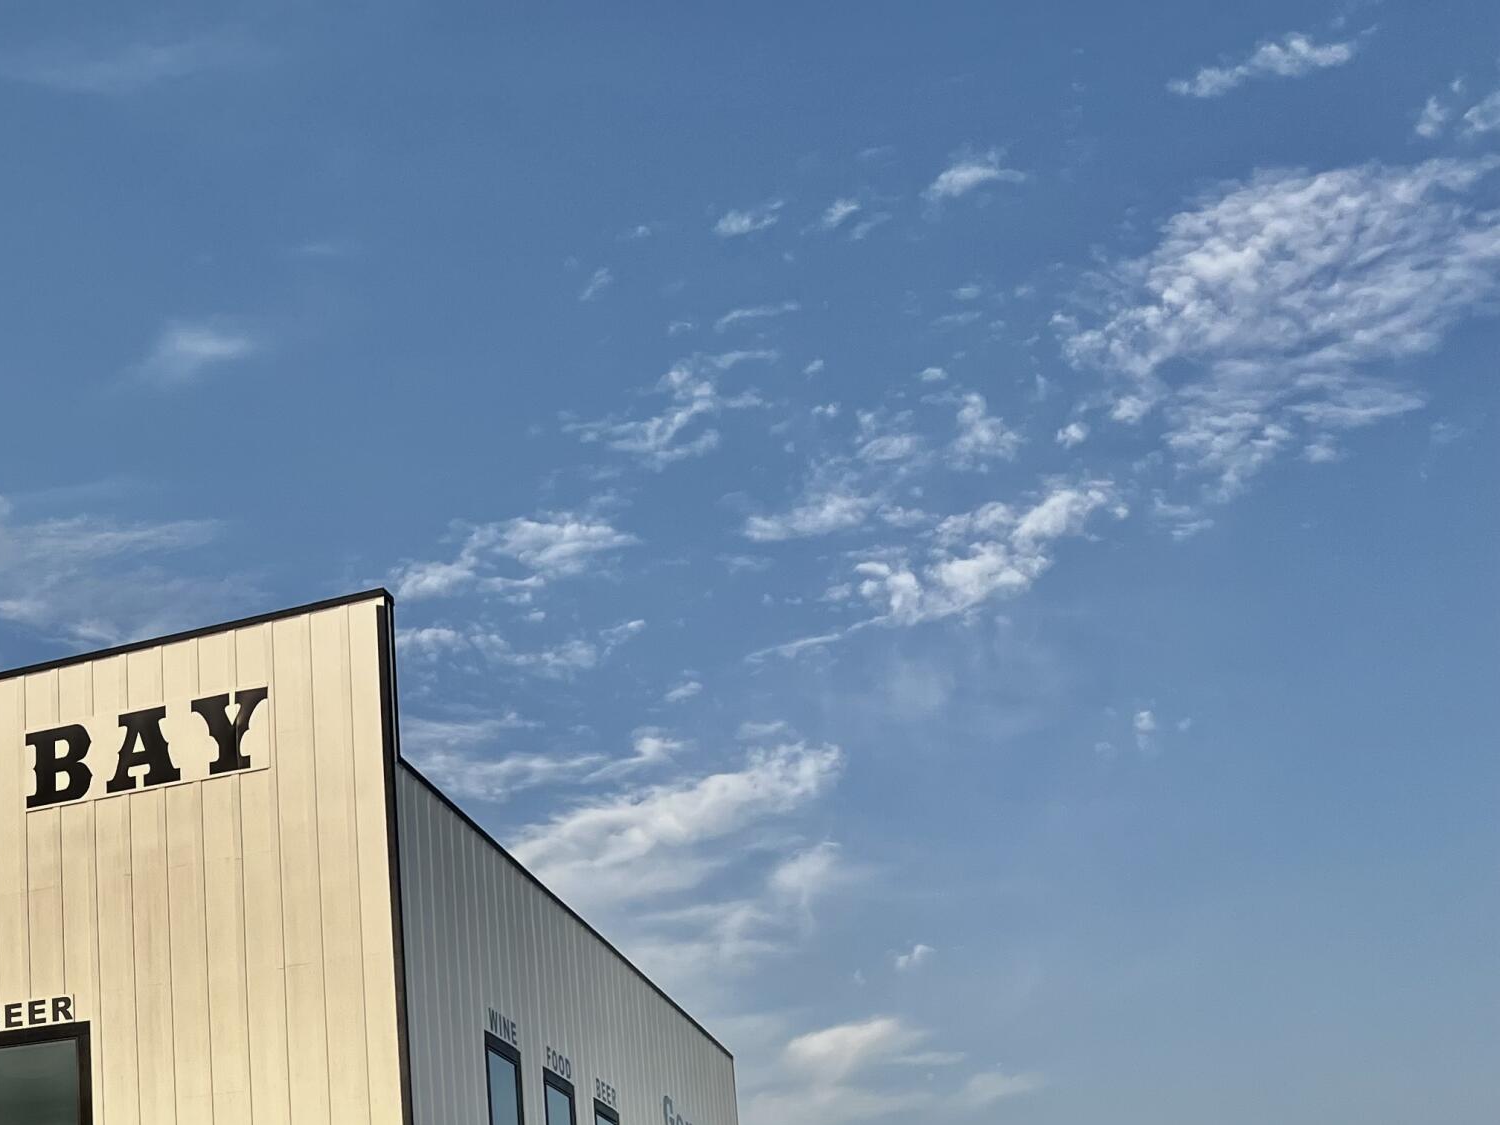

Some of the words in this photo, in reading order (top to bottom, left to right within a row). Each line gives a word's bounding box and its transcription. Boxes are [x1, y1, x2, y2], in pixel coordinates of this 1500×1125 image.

[25, 687, 268, 808] BAY
[489, 1008, 518, 1046] WINE
[546, 1046, 572, 1079] FOOD
[595, 1078, 617, 1107] BEER
